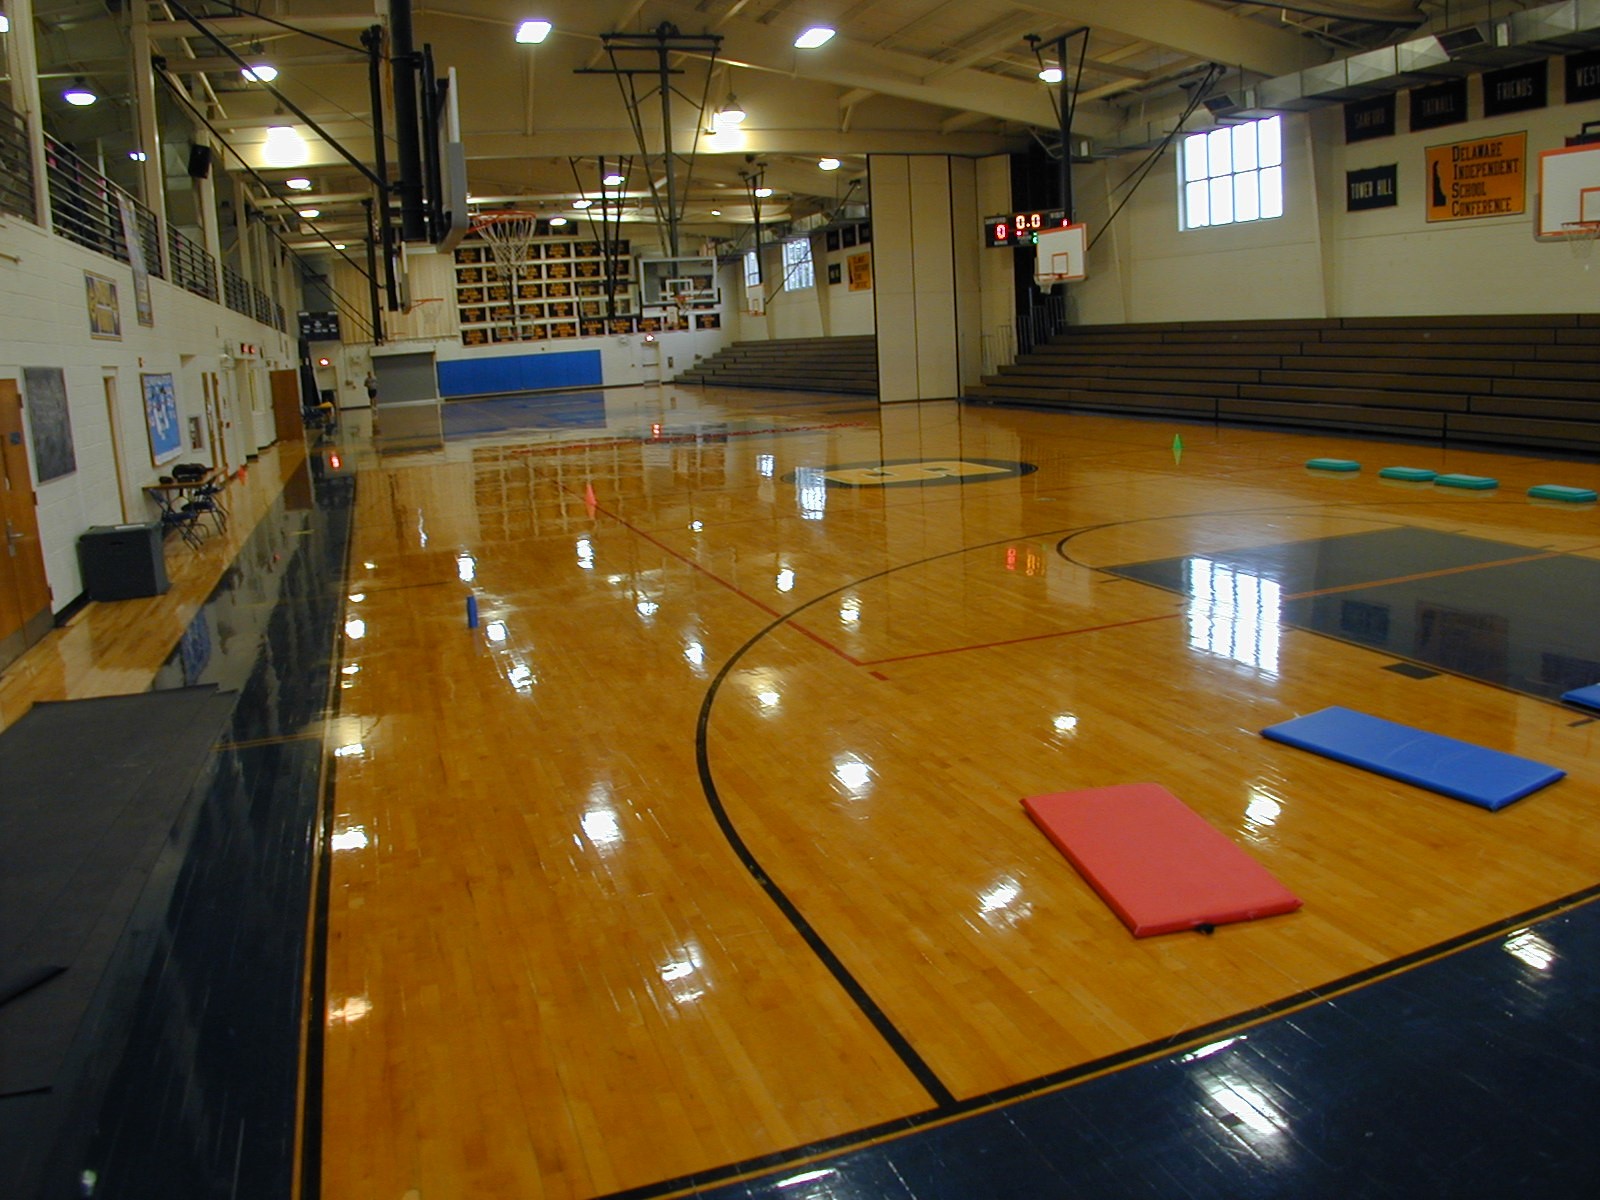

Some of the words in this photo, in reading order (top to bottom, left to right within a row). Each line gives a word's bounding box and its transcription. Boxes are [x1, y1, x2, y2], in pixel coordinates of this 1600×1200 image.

[1497, 78, 1532, 100] FRIENDS
[1452, 143, 1502, 162] DELAWARE
[1453, 159, 1519, 180] INDEPENDENT
[1351, 180, 1374, 200] TOWER
[1376, 178, 1393, 196] HILL
[1451, 181, 1487, 199] SCHOOL
[1451, 197, 1512, 217] CONFERENCE
[1015, 213, 1041, 230] 0.0
[996, 224, 1006, 240] 0
